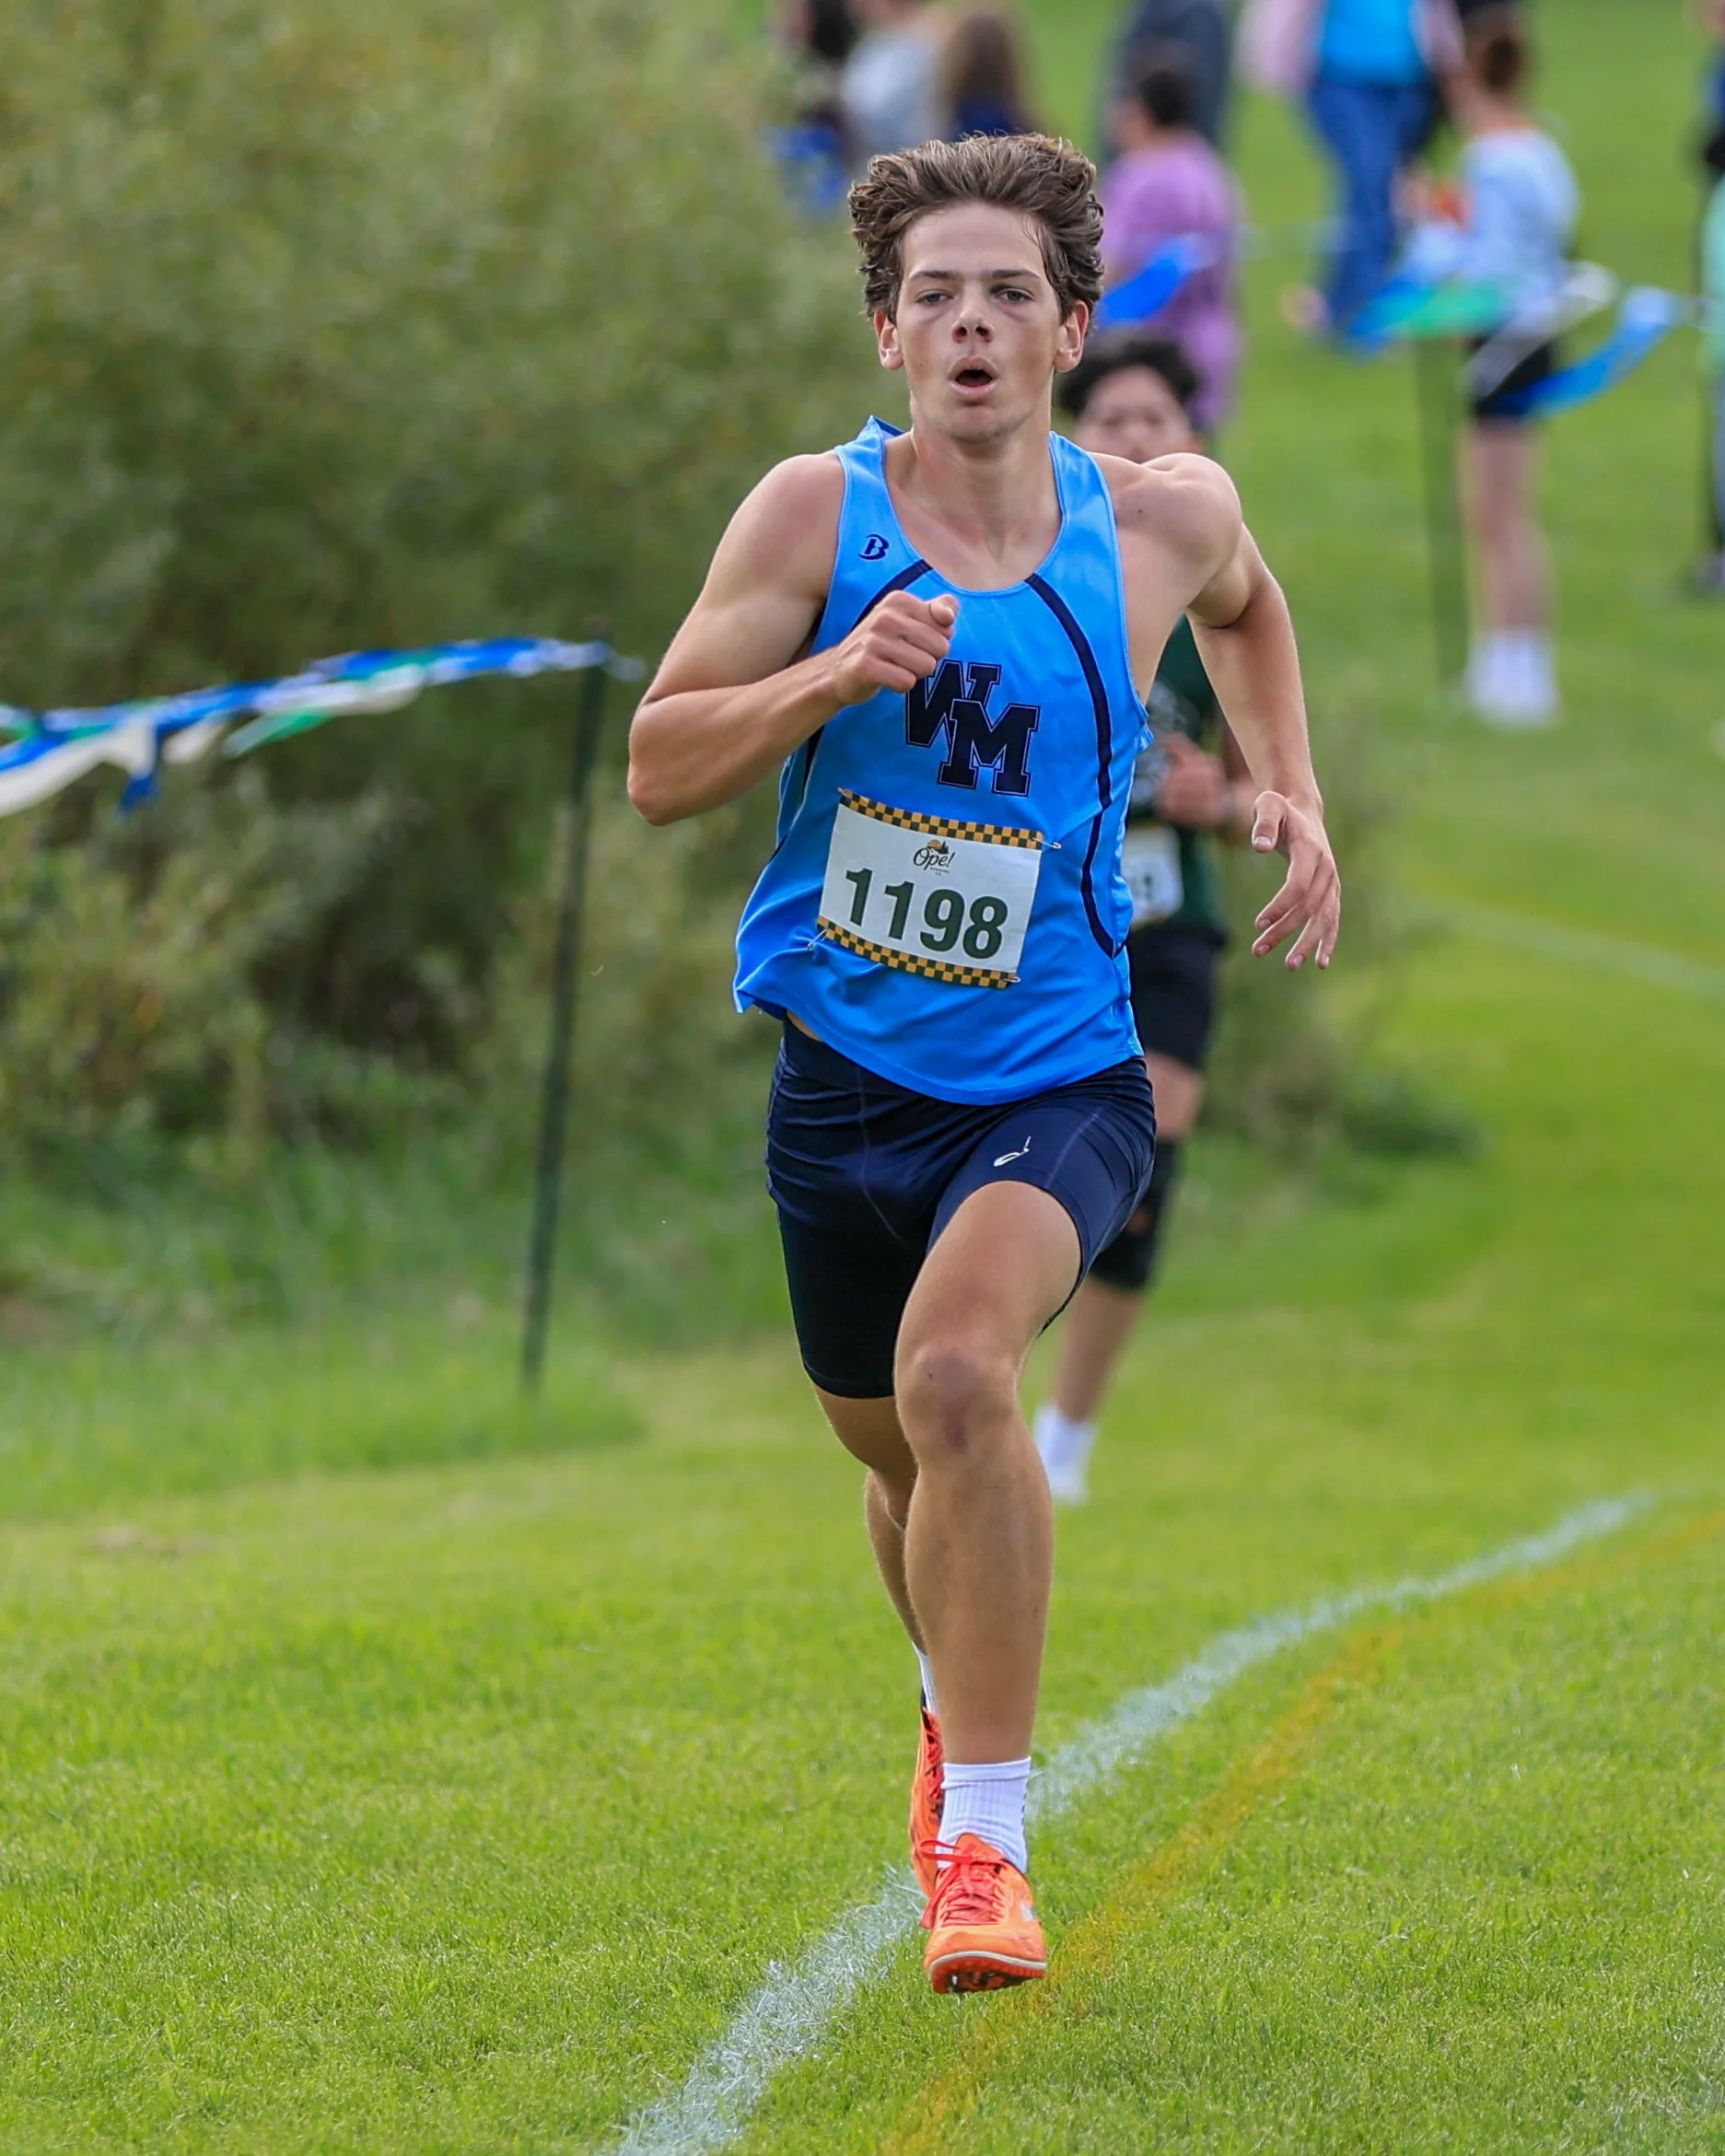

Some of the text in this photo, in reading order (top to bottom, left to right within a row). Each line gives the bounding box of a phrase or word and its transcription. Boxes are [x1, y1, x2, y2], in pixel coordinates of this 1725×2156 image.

[858, 533, 890, 560] B
[913, 846, 956, 870] Ope!
[845, 868, 1008, 960] 1198
